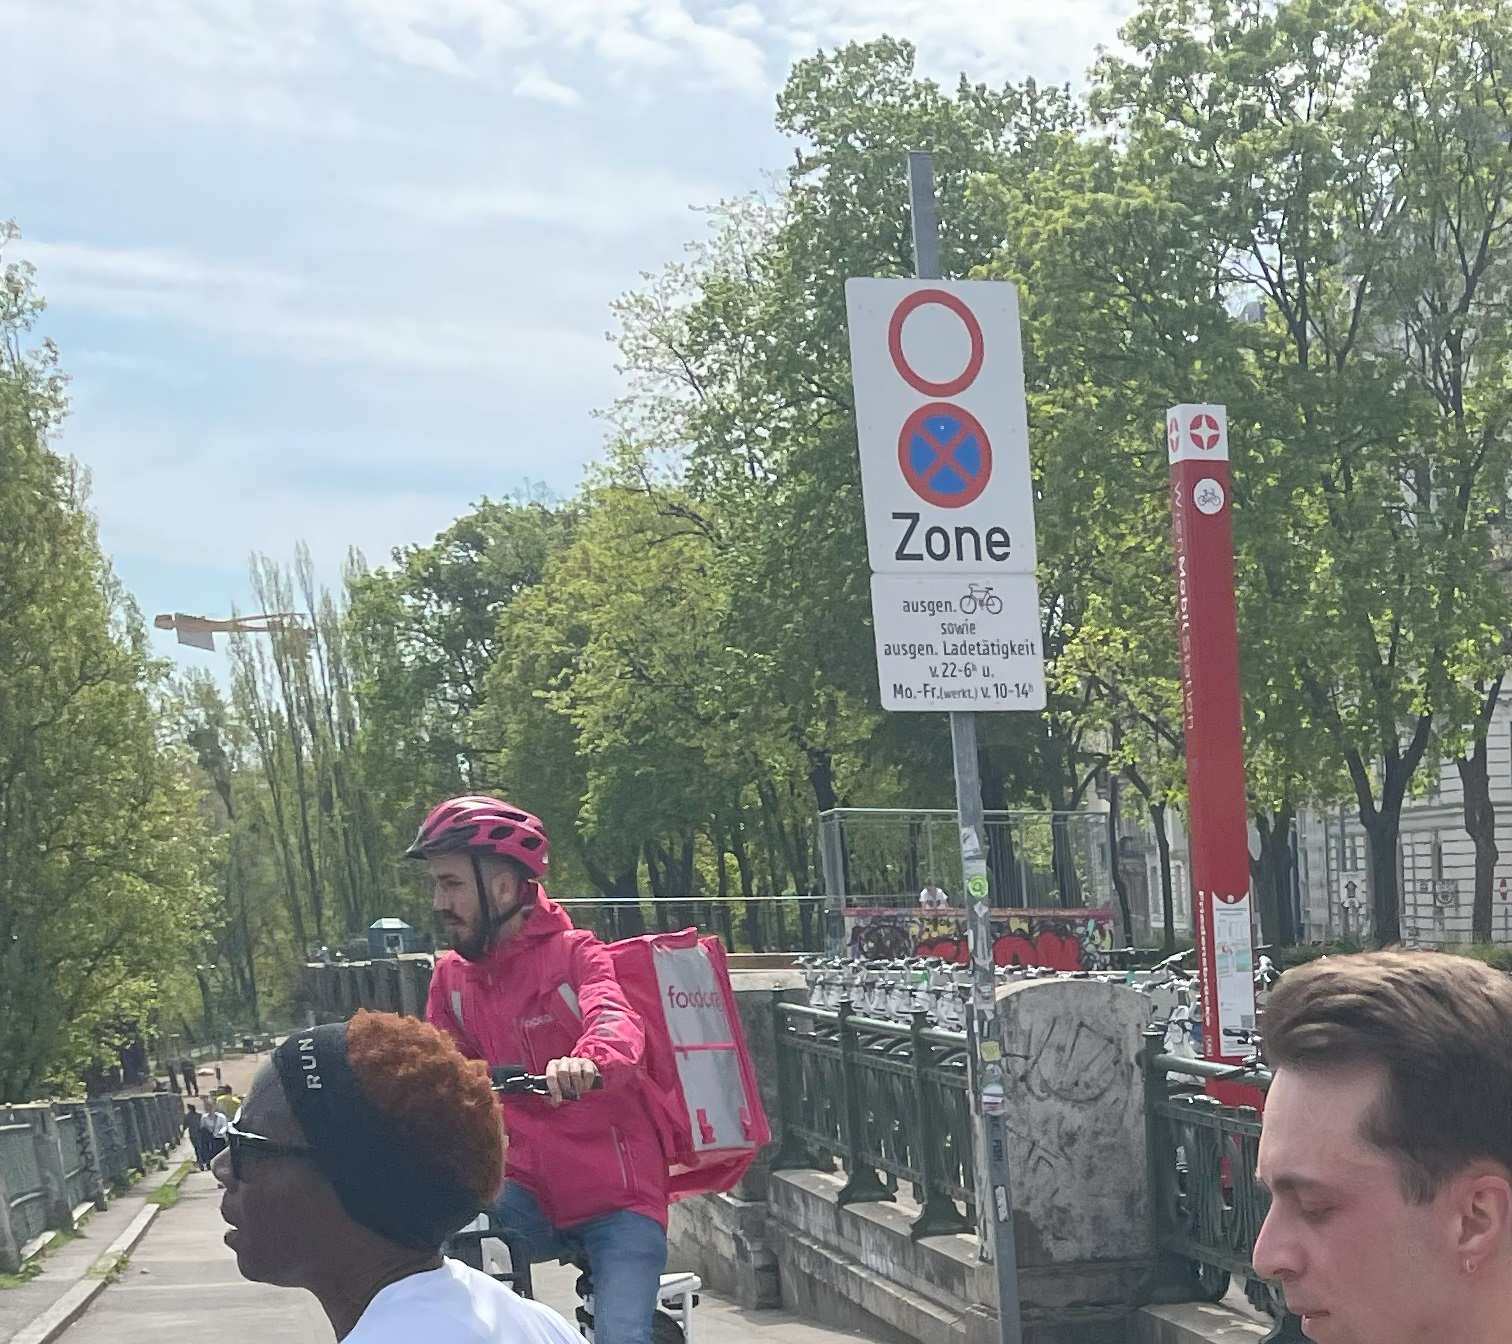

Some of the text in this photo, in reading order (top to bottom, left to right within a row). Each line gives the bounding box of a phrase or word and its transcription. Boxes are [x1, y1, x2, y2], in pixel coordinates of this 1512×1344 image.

[892, 512, 1011, 561] Zone
[902, 600, 957, 616] ausgen.
[941, 618, 976, 635] sowie
[884, 638, 1037, 659] ausgen. Ladetätigkeit
